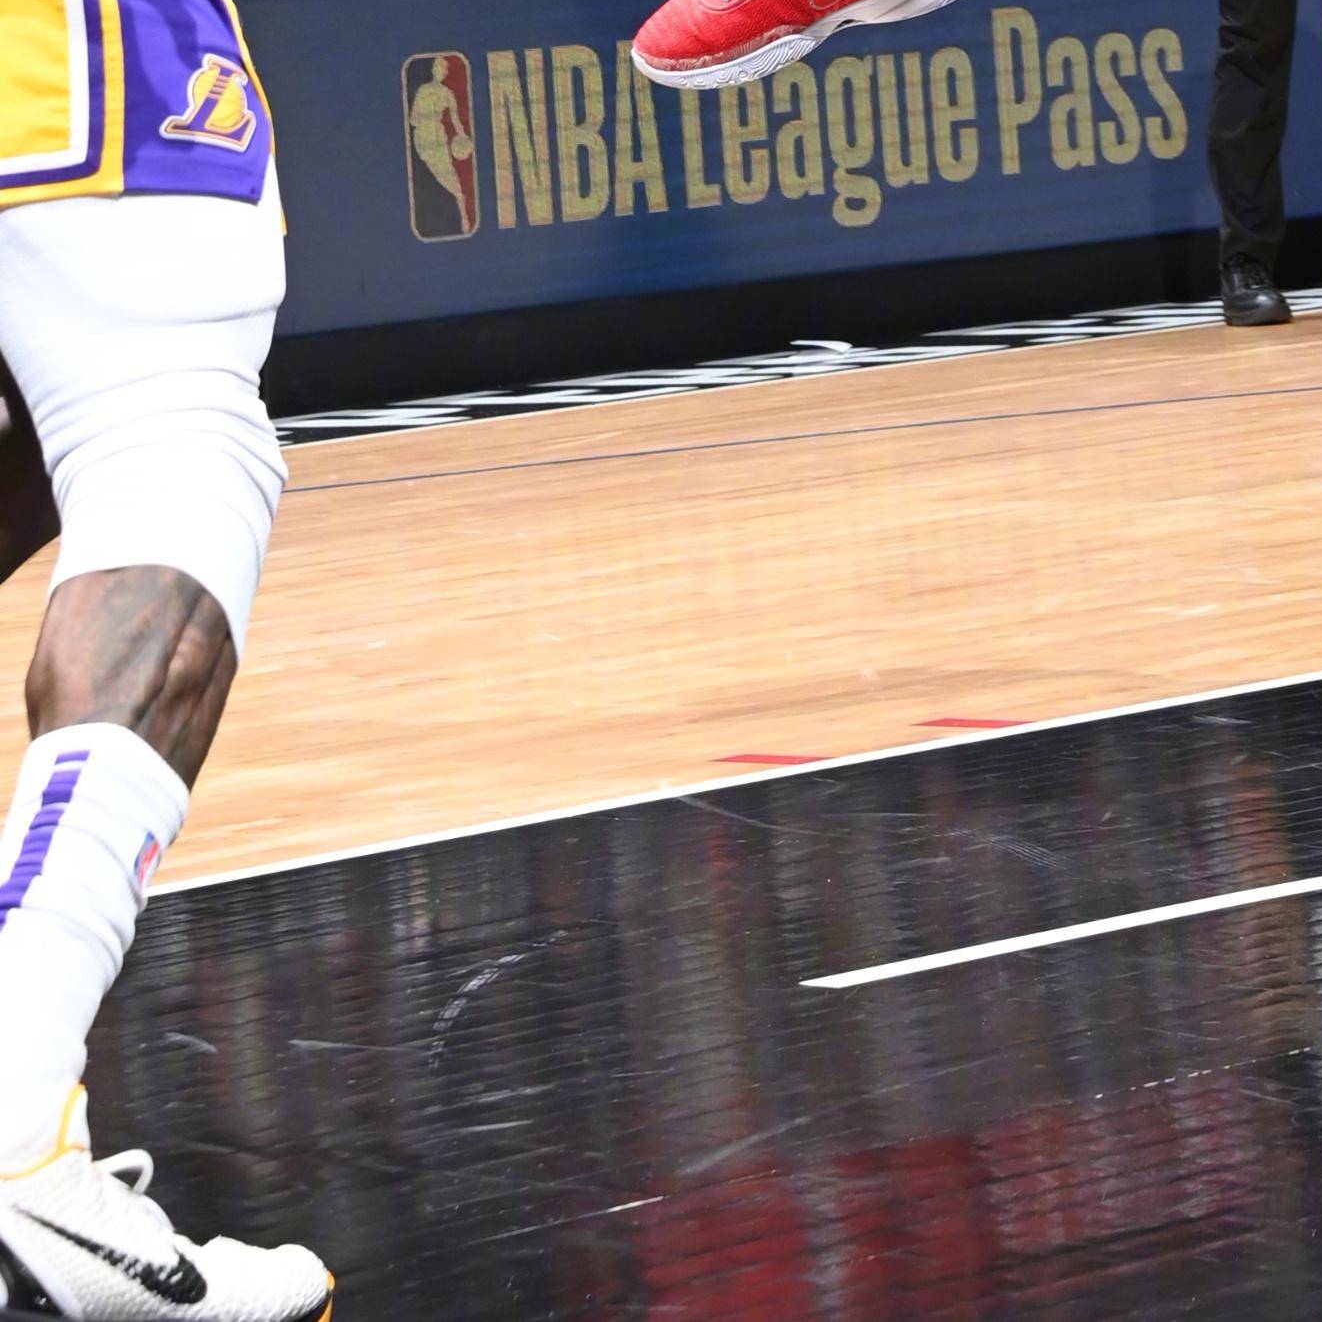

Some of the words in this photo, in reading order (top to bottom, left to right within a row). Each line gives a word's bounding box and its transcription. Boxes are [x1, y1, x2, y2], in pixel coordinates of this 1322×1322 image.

[486, 39, 671, 230] NBA
[680, 42, 978, 228] League
[990, 6, 1189, 175] Pass
